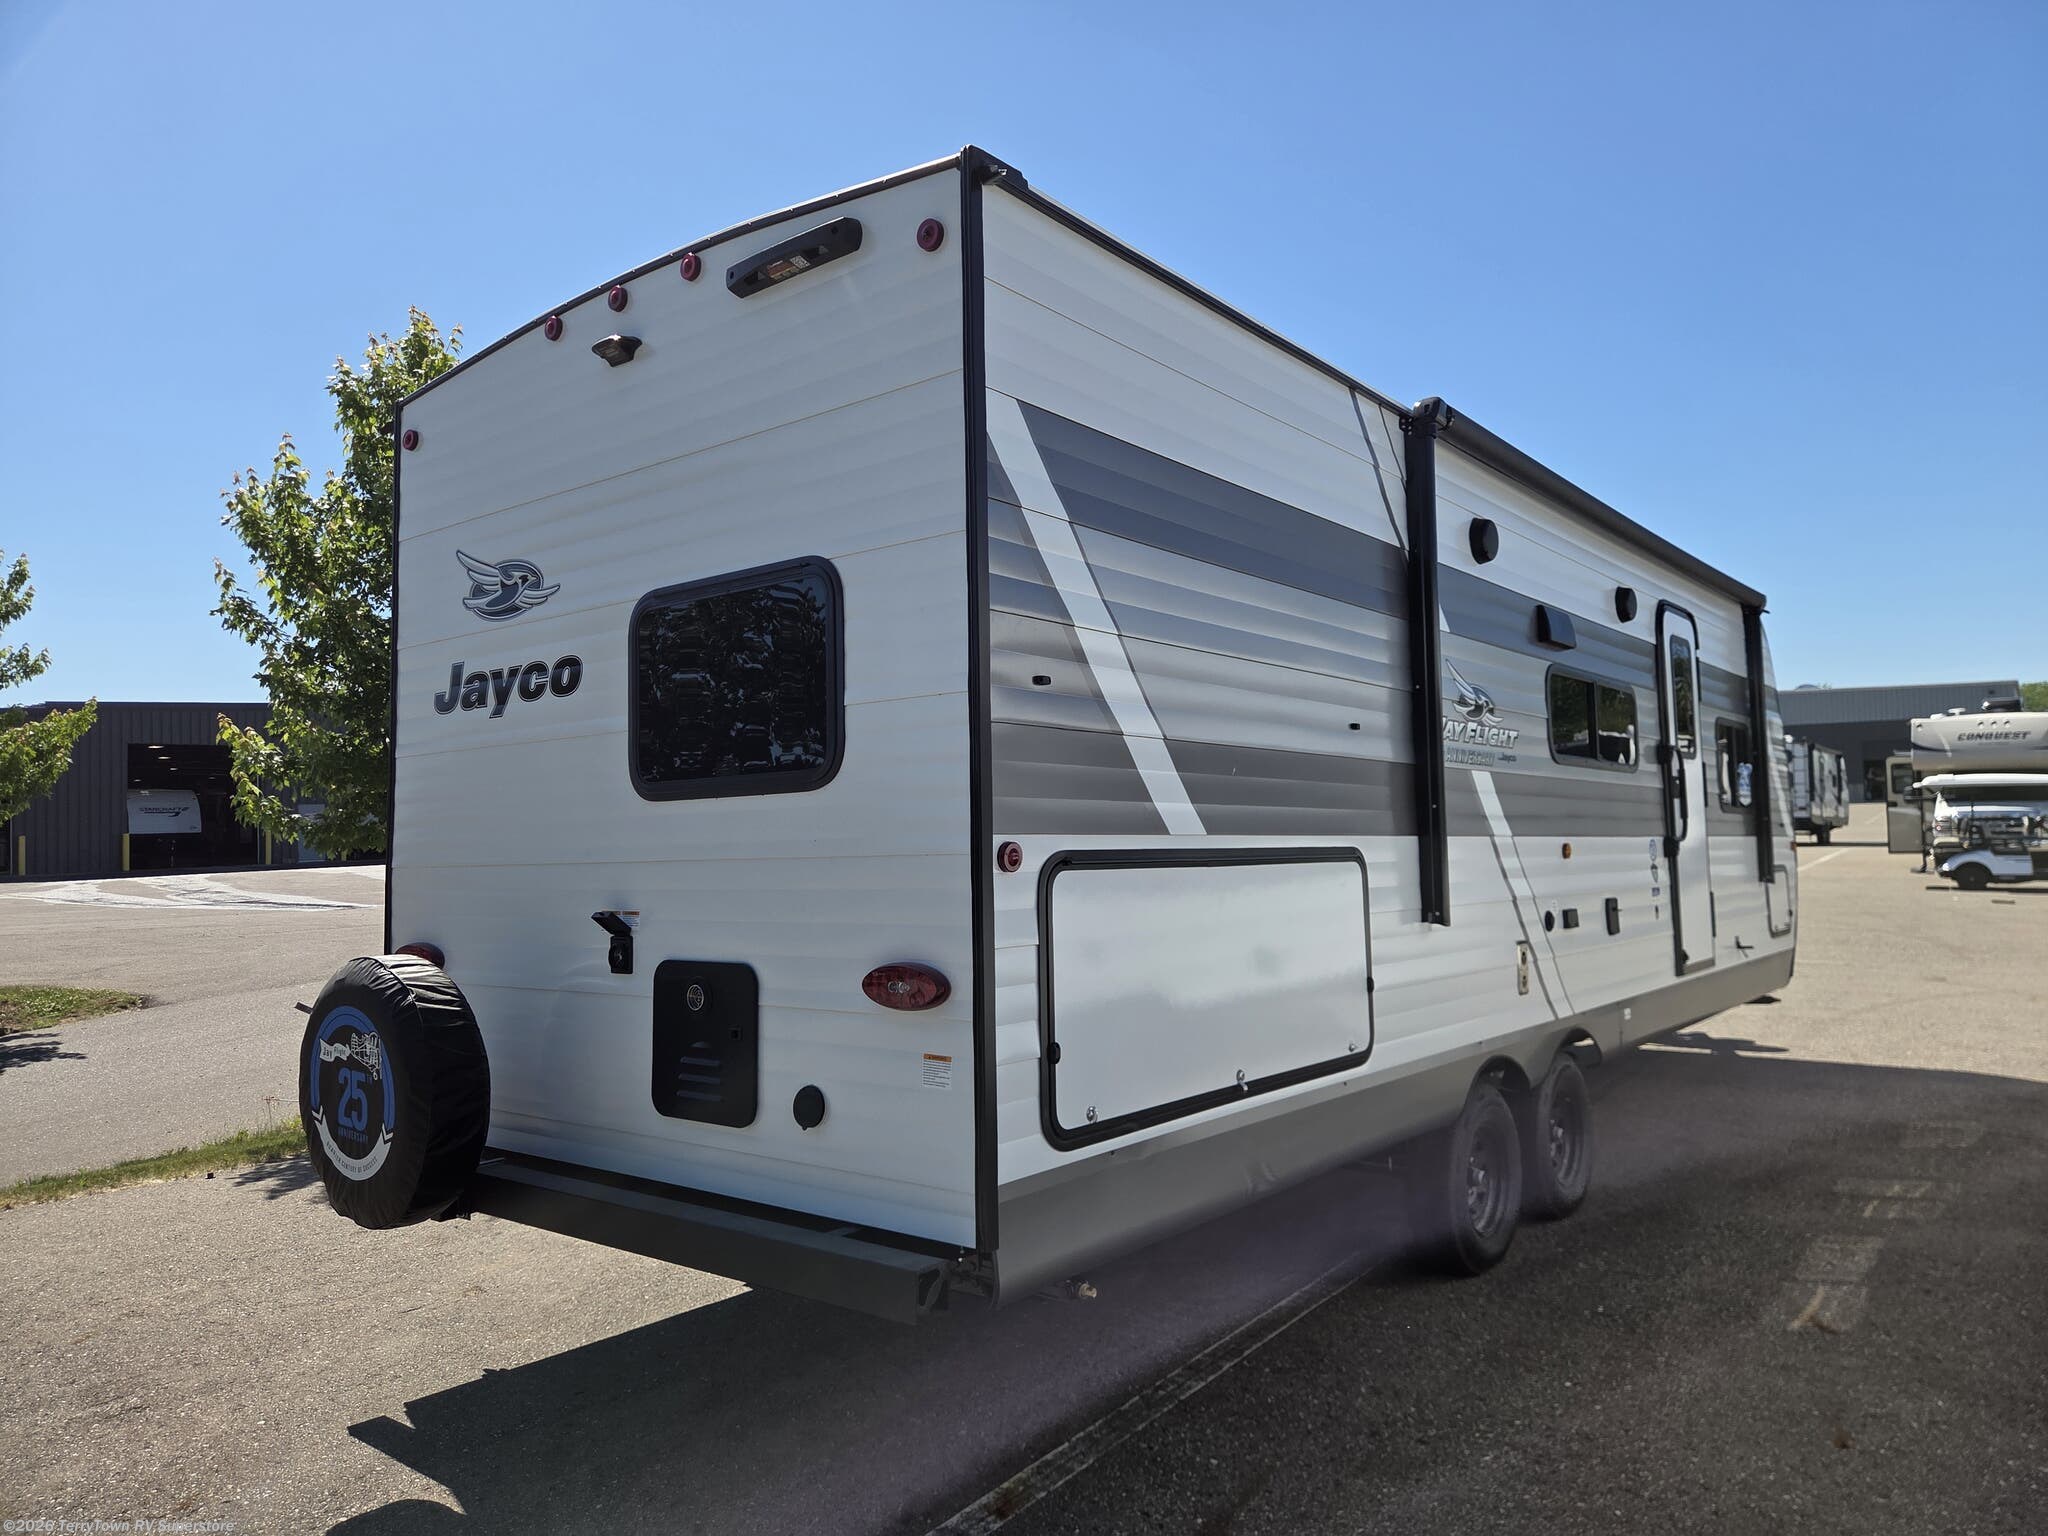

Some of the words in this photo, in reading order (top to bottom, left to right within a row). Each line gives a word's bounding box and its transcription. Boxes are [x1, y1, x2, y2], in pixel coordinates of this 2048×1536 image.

[433, 654, 584, 719] Jayco
[1464, 721, 1520, 749] FLIGHT
[1957, 730, 2031, 742] CONQUEST
